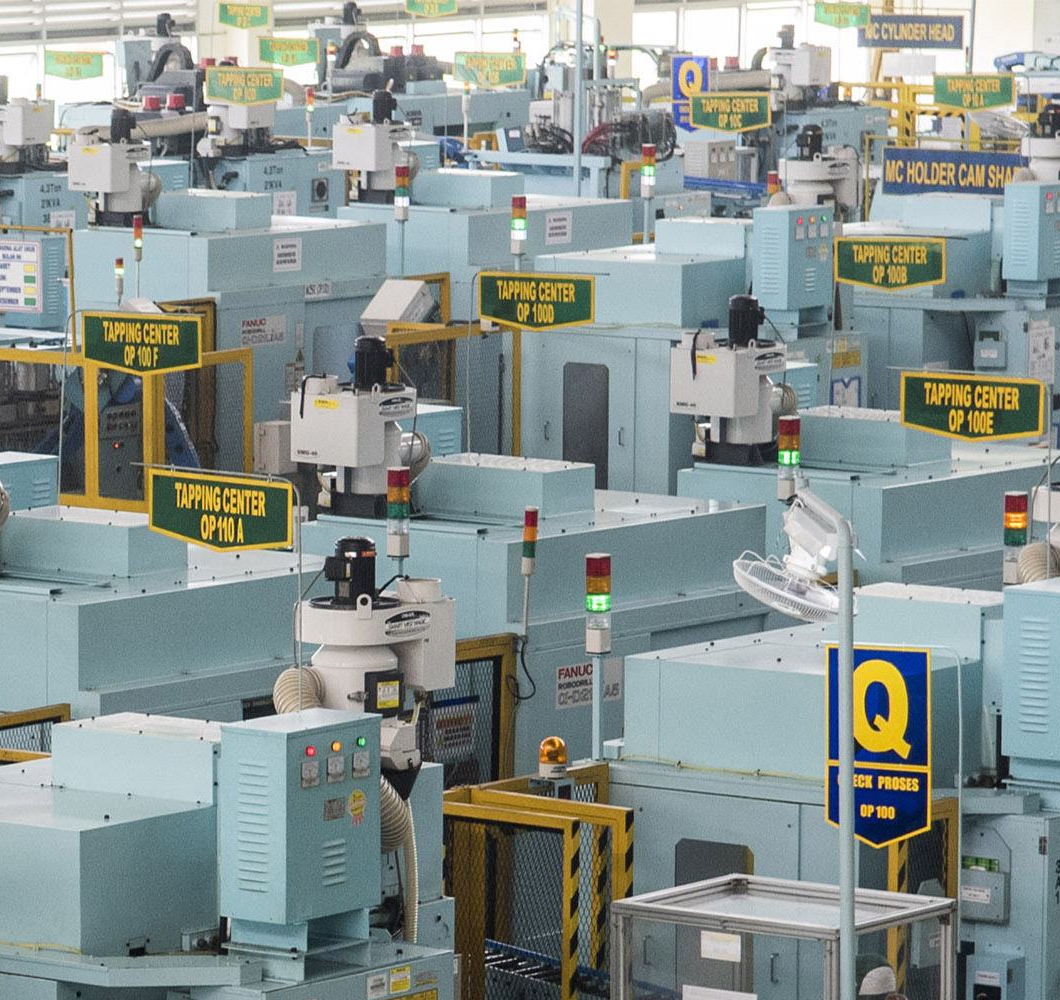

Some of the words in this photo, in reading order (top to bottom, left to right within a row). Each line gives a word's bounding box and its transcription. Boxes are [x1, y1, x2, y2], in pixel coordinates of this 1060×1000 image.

[882, 23, 927, 41] CYLINDER
[929, 24, 955, 42] HEAD
[218, 73, 245, 86] TAPPING
[246, 73, 273, 87] CENTER
[678, 60, 703, 97] Q
[947, 78, 973, 92] TAPPING
[975, 79, 1000, 93] CENTER
[702, 99, 731, 113] TAPPING
[732, 99, 759, 113] CENTER
[719, 114, 729, 128] OP
[886, 162, 903, 181] MC
[905, 162, 956, 187] HOLDER
[958, 163, 985, 188] CAM
[852, 244, 890, 263] TAPPING
[892, 245, 928, 264] CENTER
[872, 264, 884, 283] OP
[497, 280, 536, 300] TAPPING
[538, 282, 576, 302] CENTER
[517, 302, 530, 321] OP
[532, 303, 555, 323] 100D
[242, 318, 266, 328] FANUC
[102, 321, 141, 344] TAPPING
[143, 322, 179, 346] CENTER
[124, 345, 135, 367] OP
[137, 346, 152, 367] 100
[153, 347, 159, 367] F
[924, 382, 972, 407] TAPPING
[974, 384, 1020, 411] CENTER
[948, 408, 964, 433] OP
[966, 410, 994, 435] 100E
[175, 482, 221, 511] TAPPING
[223, 487, 266, 517] CENTER
[200, 514, 216, 541] OP
[217, 516, 235, 543] 110
[237, 518, 244, 544] A
[558, 663, 593, 680] FANUC
[853, 659, 912, 760] Q
[877, 776, 919, 792] PROSES
[860, 804, 874, 818] OP
[876, 805, 895, 819] 100
